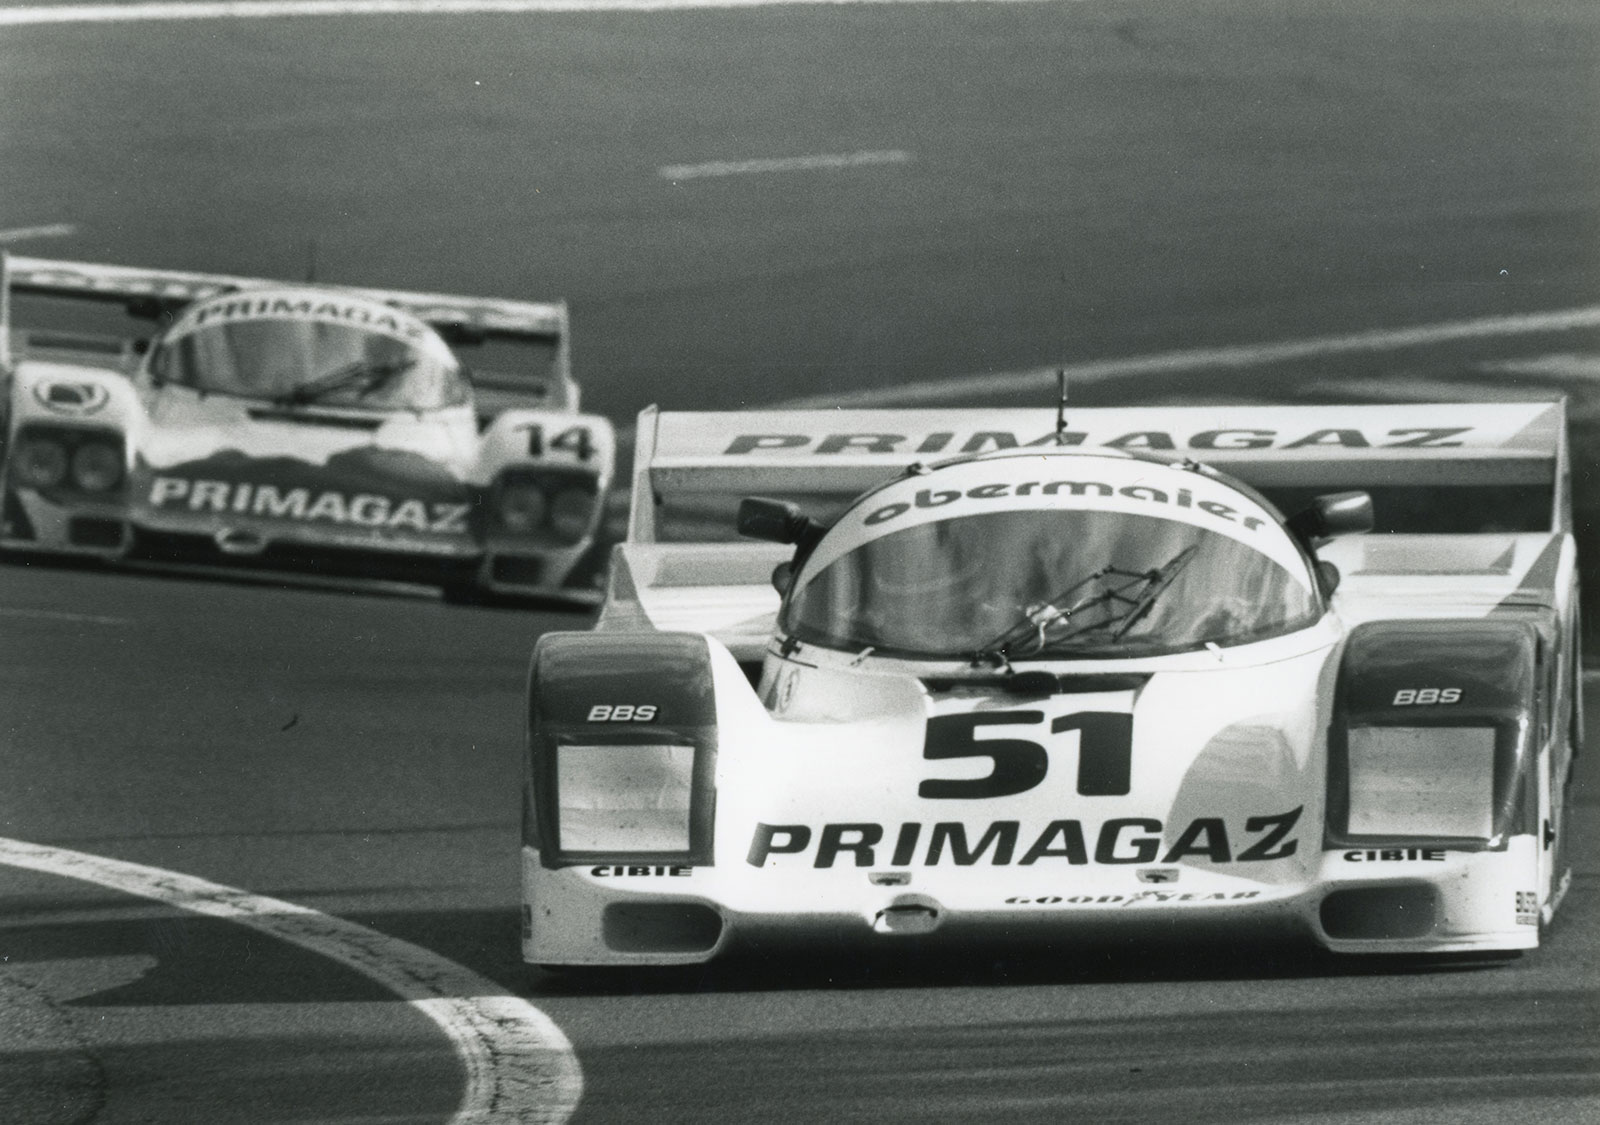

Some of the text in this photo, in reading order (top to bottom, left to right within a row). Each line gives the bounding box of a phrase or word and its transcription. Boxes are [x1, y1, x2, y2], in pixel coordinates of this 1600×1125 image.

[515, 424, 595, 460] 14
[724, 427, 1470, 454] PRIMAGAZ
[150, 477, 471, 533] PRIMAGAZ
[863, 481, 1268, 530] obermaier
[588, 705, 657, 722] BBS
[1393, 688, 1462, 705] BBS
[918, 711, 1133, 799] 51
[747, 805, 1304, 868] PRIMAGAZ
[591, 866, 693, 878] CIBIE
